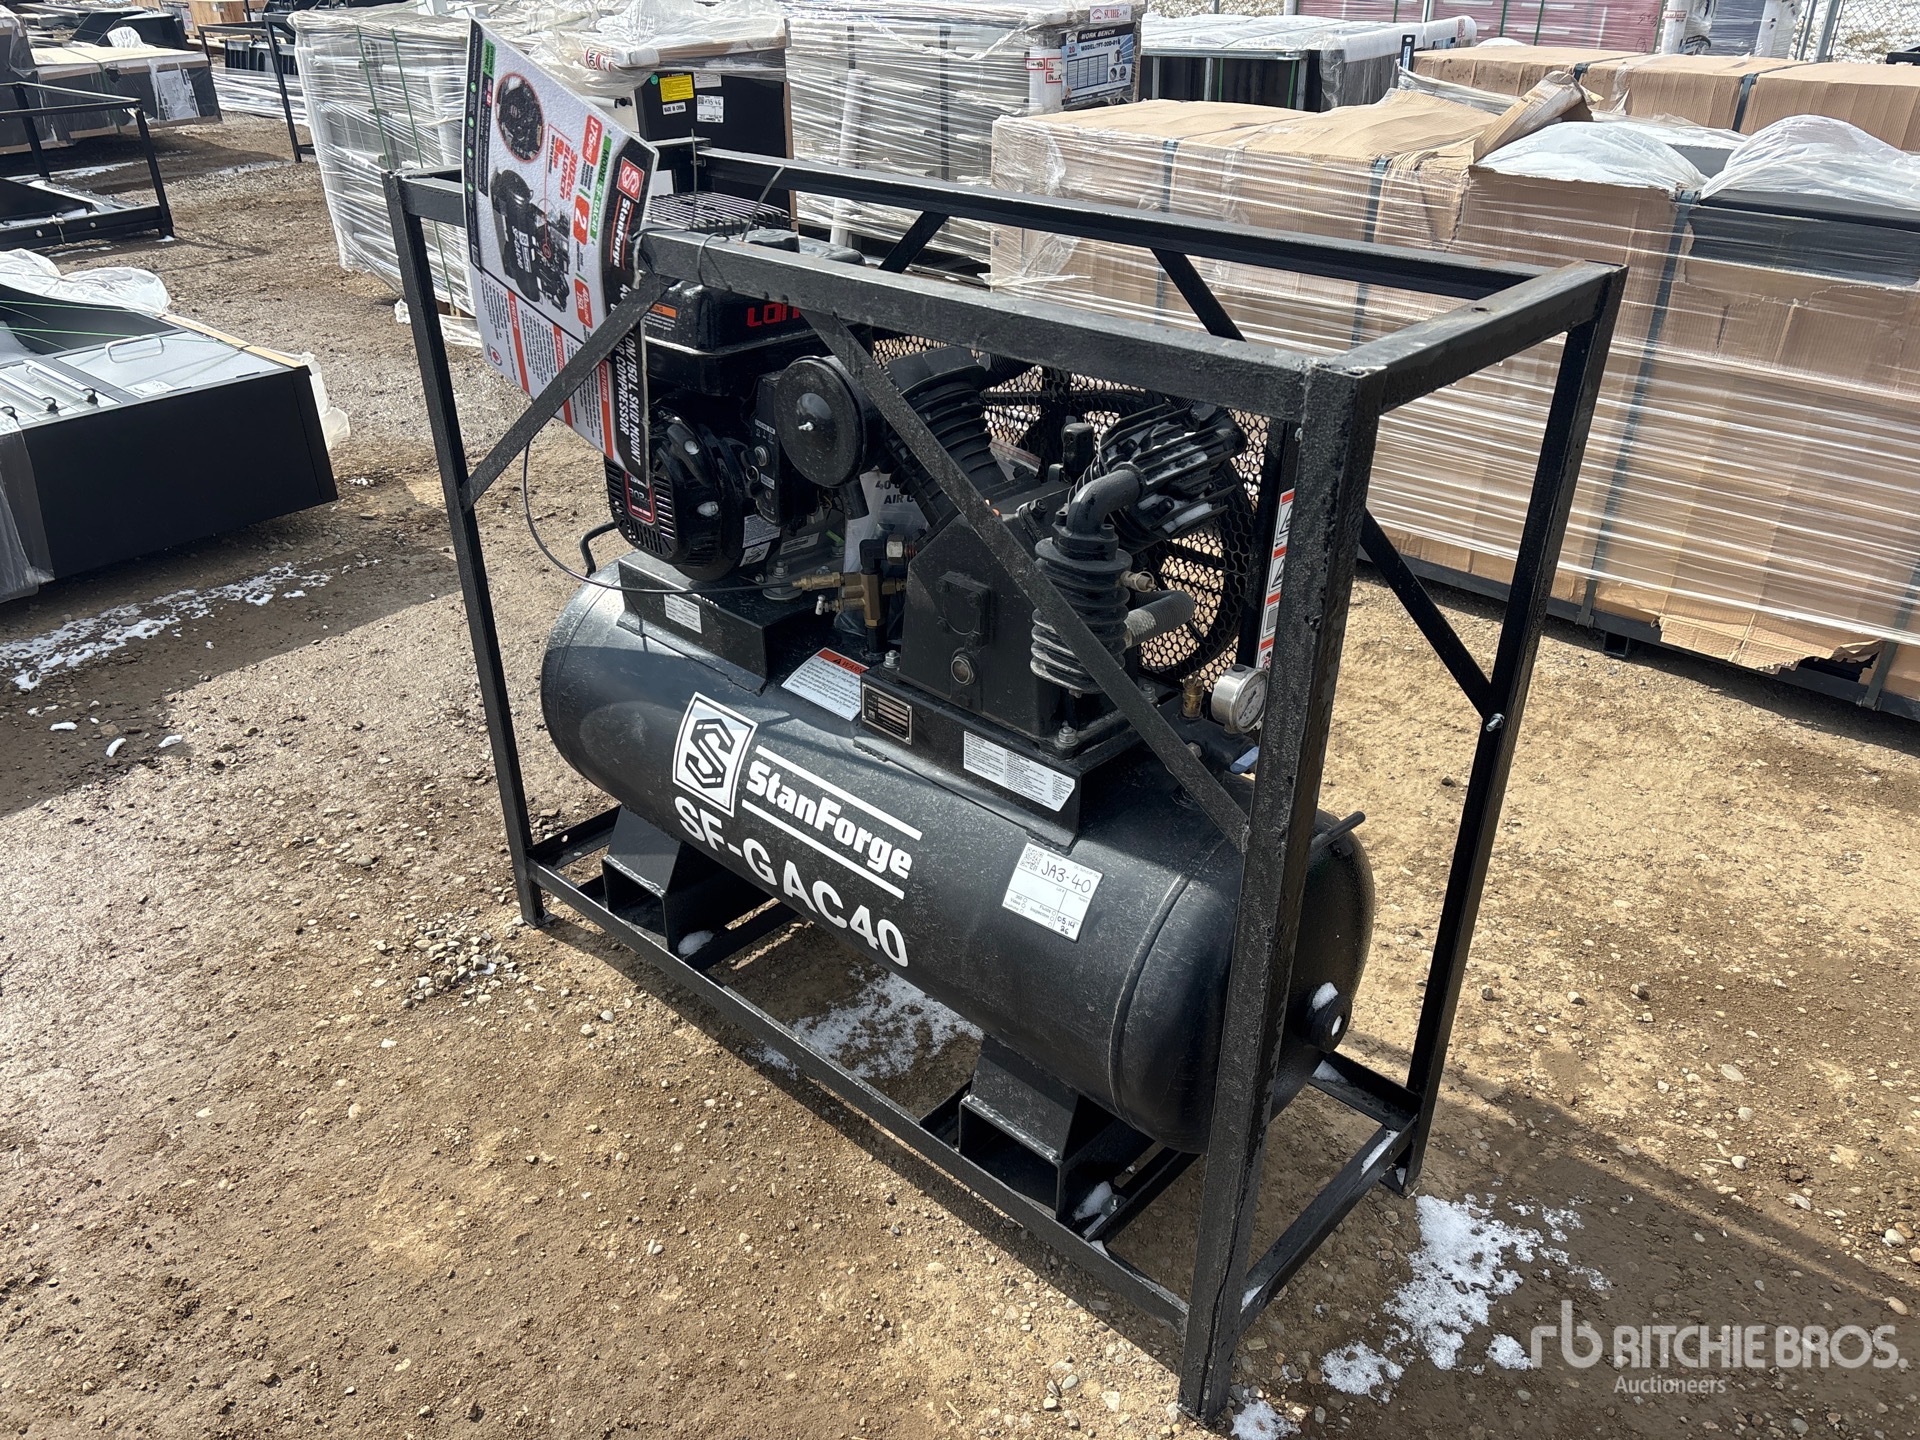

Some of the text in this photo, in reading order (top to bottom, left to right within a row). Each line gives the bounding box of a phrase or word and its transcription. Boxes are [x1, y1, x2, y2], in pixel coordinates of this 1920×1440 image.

[1097, 28, 1116, 38] BENCH
[598, 149, 610, 182] MODEL
[575, 207, 588, 231] 2
[613, 198, 632, 268] StanForge
[510, 300, 519, 330] ENGINE
[600, 364, 608, 403] FEATURES
[615, 356, 630, 435] COMPRESSOR
[628, 393, 640, 423] SKID
[629, 422, 642, 466] MOUNT
[746, 760, 913, 879] StanForge
[674, 796, 909, 967] SF-GAC40
[1041, 860, 1092, 893] JA3-40
